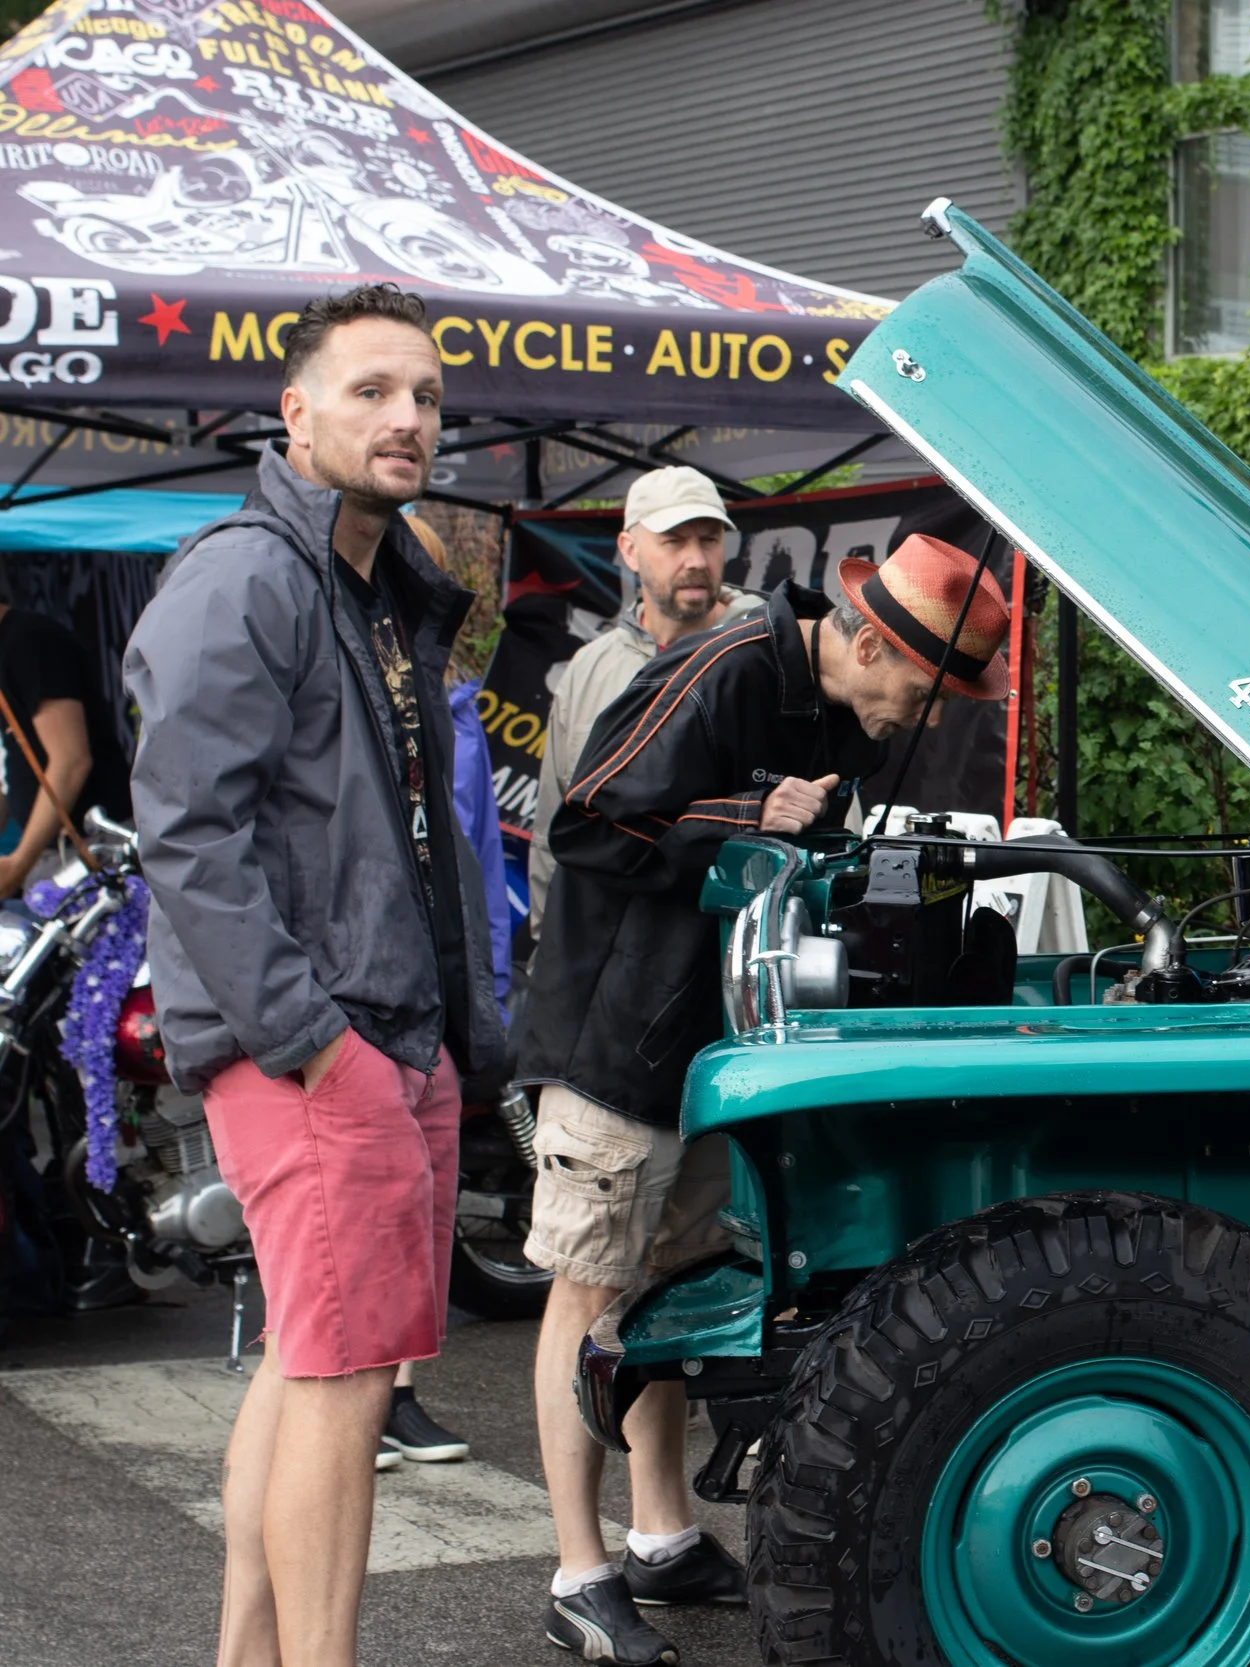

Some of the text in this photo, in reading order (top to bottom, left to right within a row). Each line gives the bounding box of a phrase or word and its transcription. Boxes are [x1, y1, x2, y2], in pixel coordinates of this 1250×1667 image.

[198, 38, 395, 109] FULL TANK
[222, 67, 399, 137] RIDE
[90, 145, 164, 178] ROAD
[646, 328, 792, 383] AUTO
